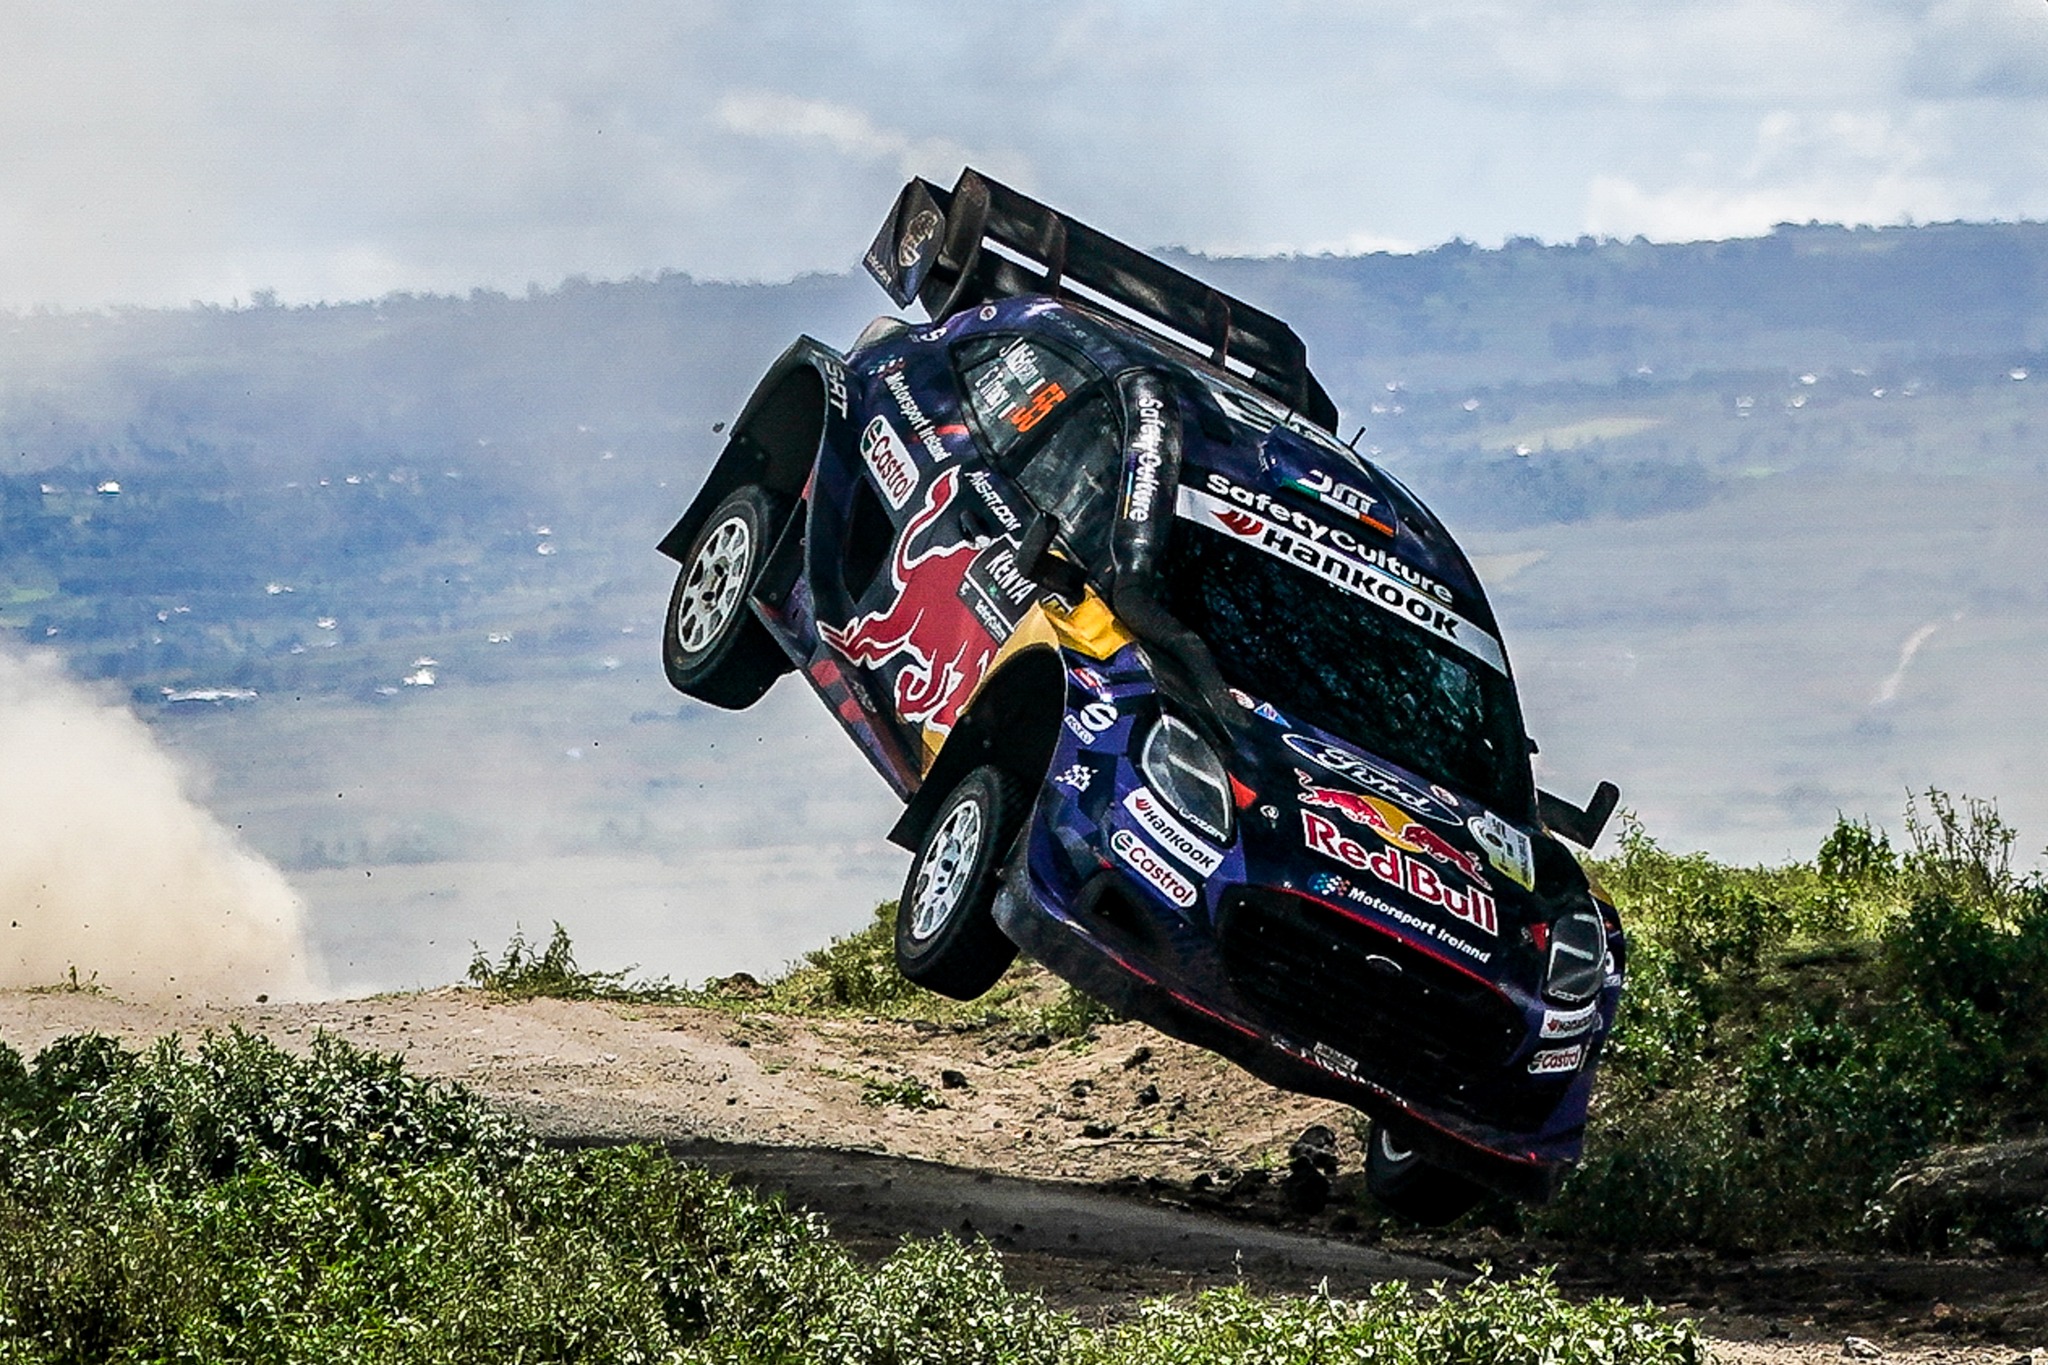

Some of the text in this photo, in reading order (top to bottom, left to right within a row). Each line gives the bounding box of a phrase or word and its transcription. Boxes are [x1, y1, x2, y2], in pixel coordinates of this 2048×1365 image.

[884, 371, 952, 463] Motorsport Ireland
[1012, 382, 1067, 432] 55
[871, 436, 915, 502] Castrol
[1129, 397, 1165, 522] SafetyCulture
[1206, 473, 1453, 600] SafetyCulture
[985, 549, 1037, 605] KENYA
[1317, 747, 1431, 812] Ford
[1128, 847, 1193, 904] Castrol
[1300, 808, 1404, 890] Red
[1405, 855, 1499, 937] Bull
[1347, 886, 1492, 964] Motorsport Ireland
